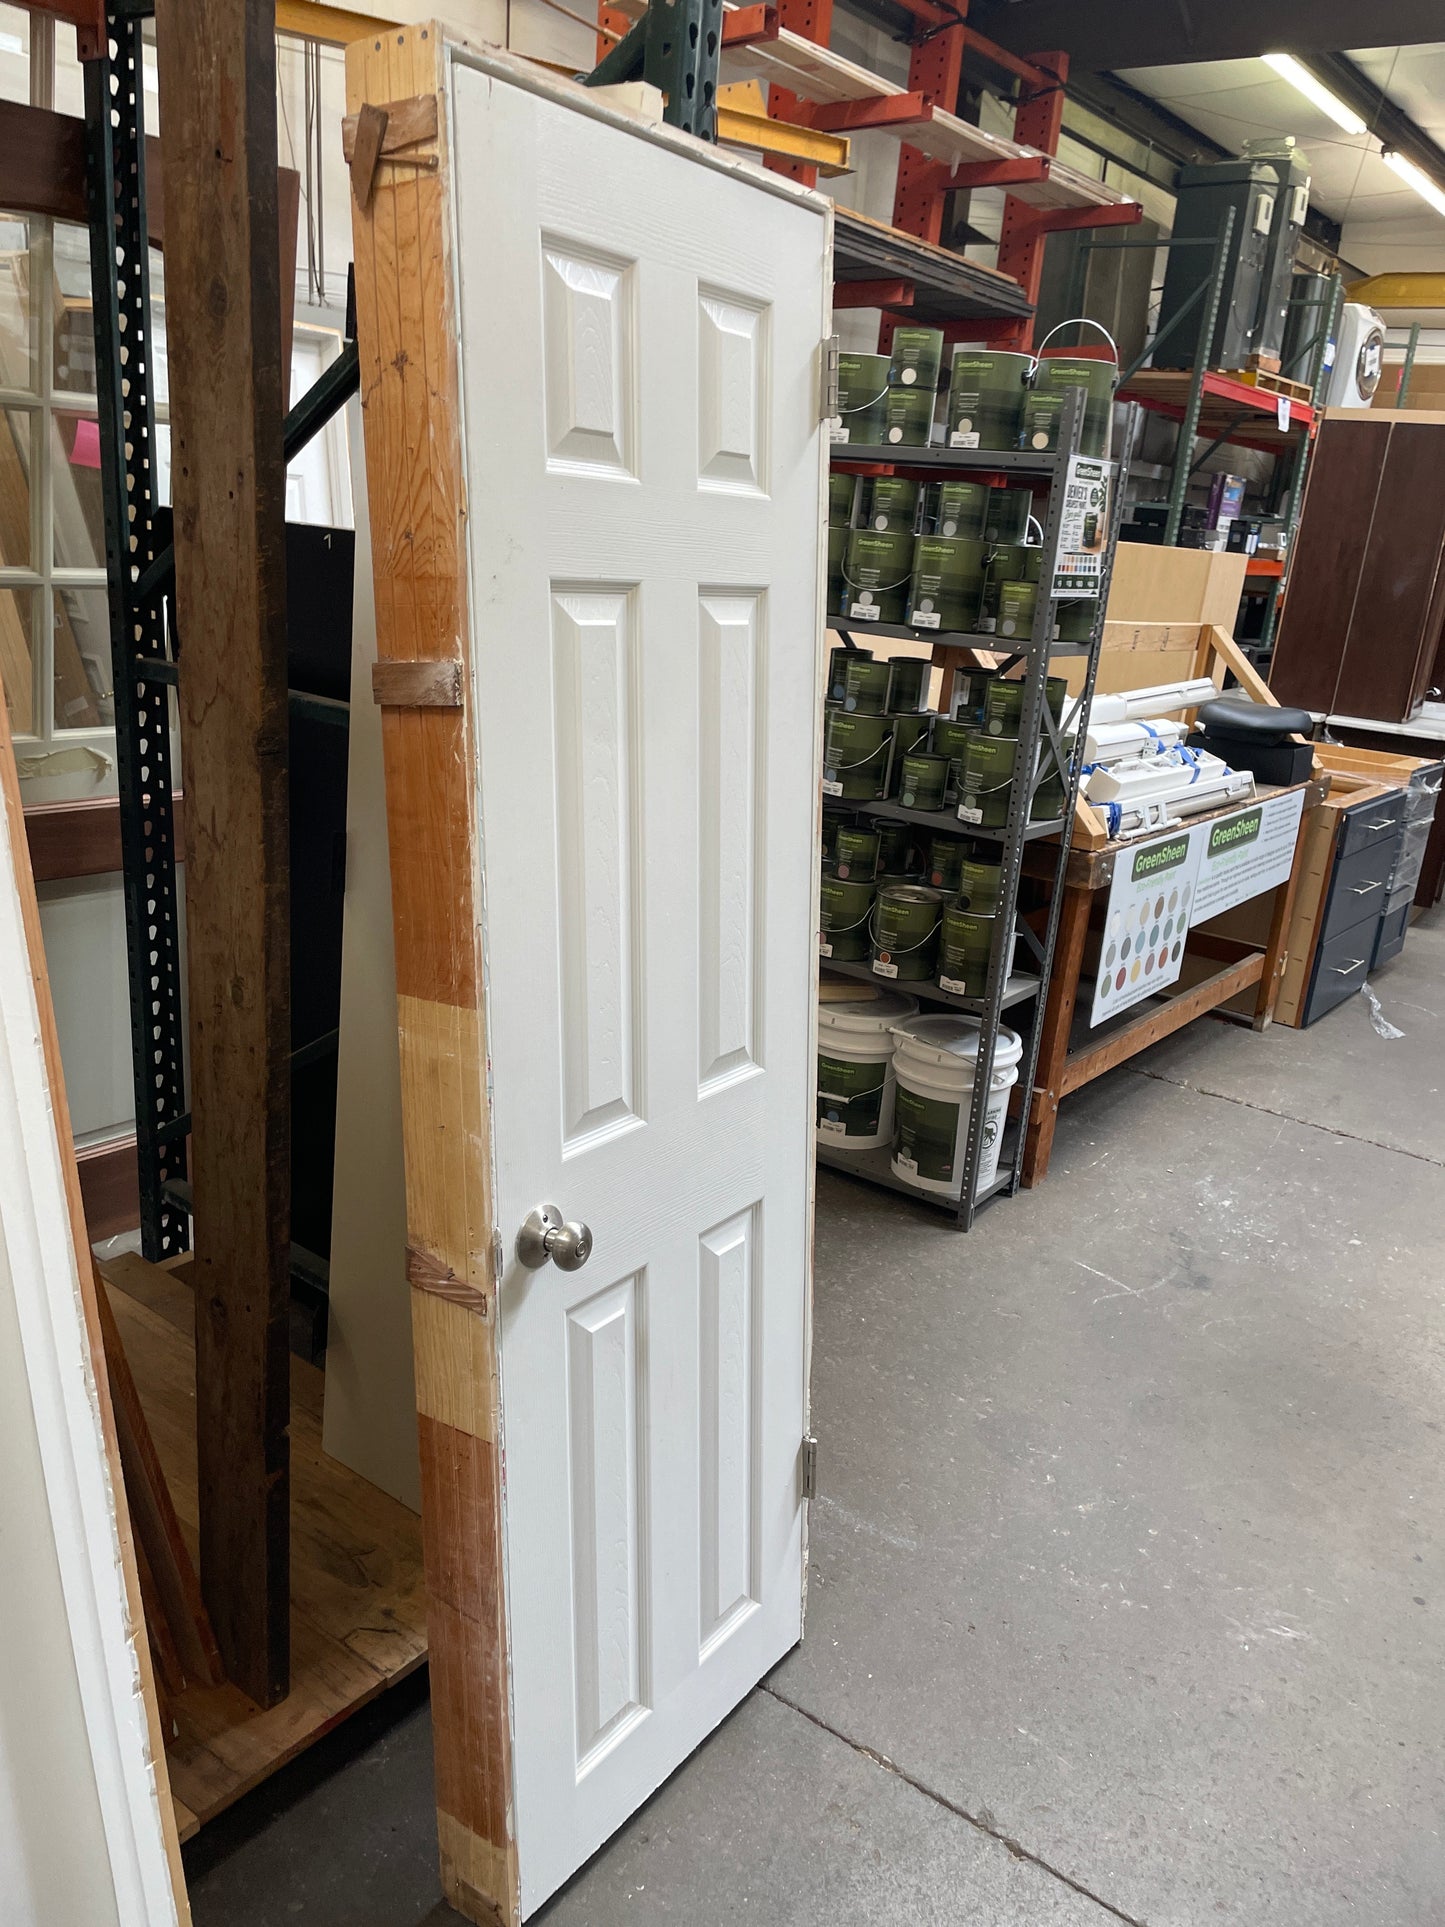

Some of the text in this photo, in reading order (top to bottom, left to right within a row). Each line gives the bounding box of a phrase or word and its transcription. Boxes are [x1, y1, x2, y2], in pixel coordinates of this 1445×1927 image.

[948, 730, 966, 738] Green
[1211, 818, 1259, 847] GreenSheen
[1135, 844, 1186, 872] GreenSheen
